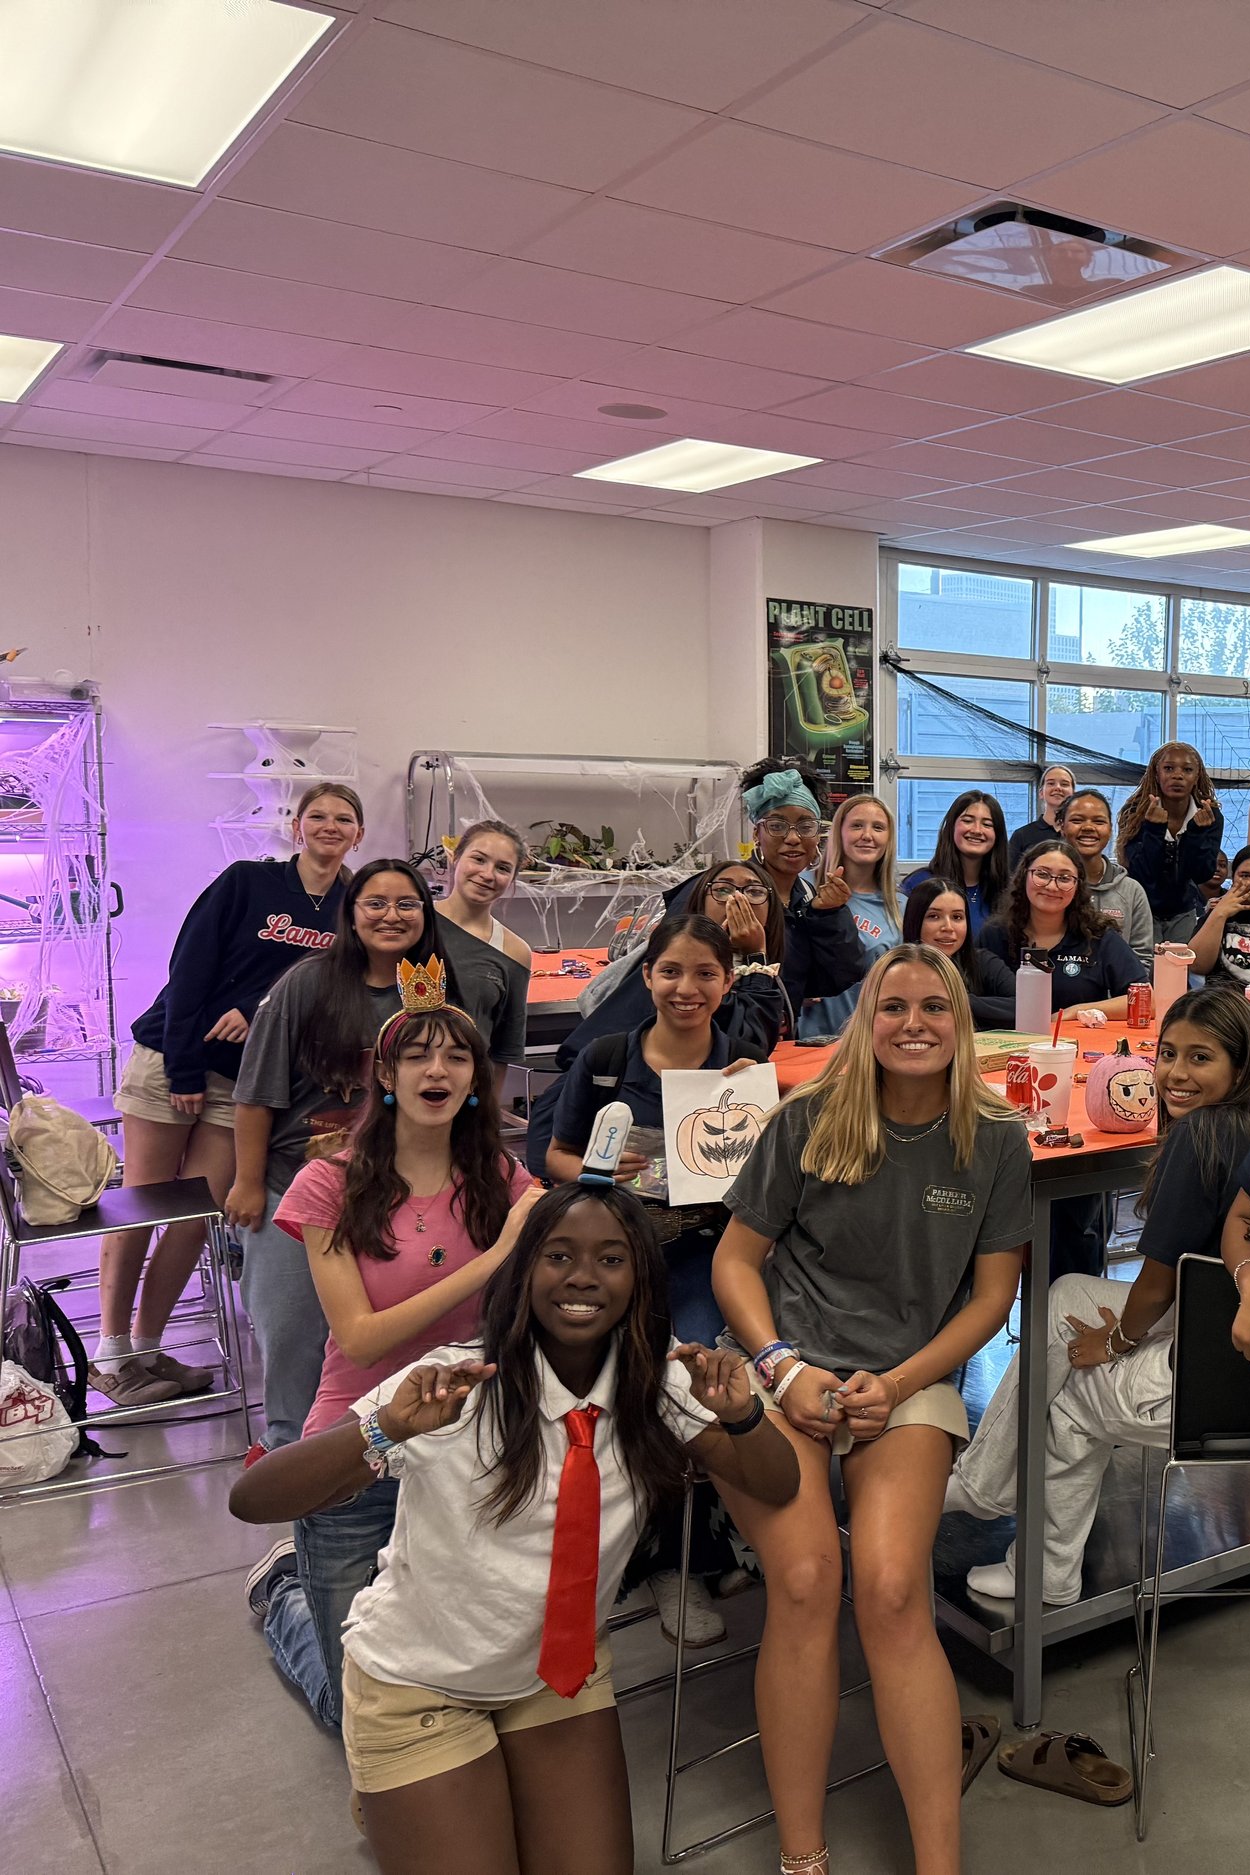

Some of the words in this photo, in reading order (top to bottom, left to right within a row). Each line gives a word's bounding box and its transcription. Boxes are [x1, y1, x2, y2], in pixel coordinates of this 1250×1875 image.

[768, 601, 827, 628] PLANT
[831, 608, 872, 632] CELL
[258, 913, 336, 949] Lama
[932, 1189, 967, 1200] PARKER
